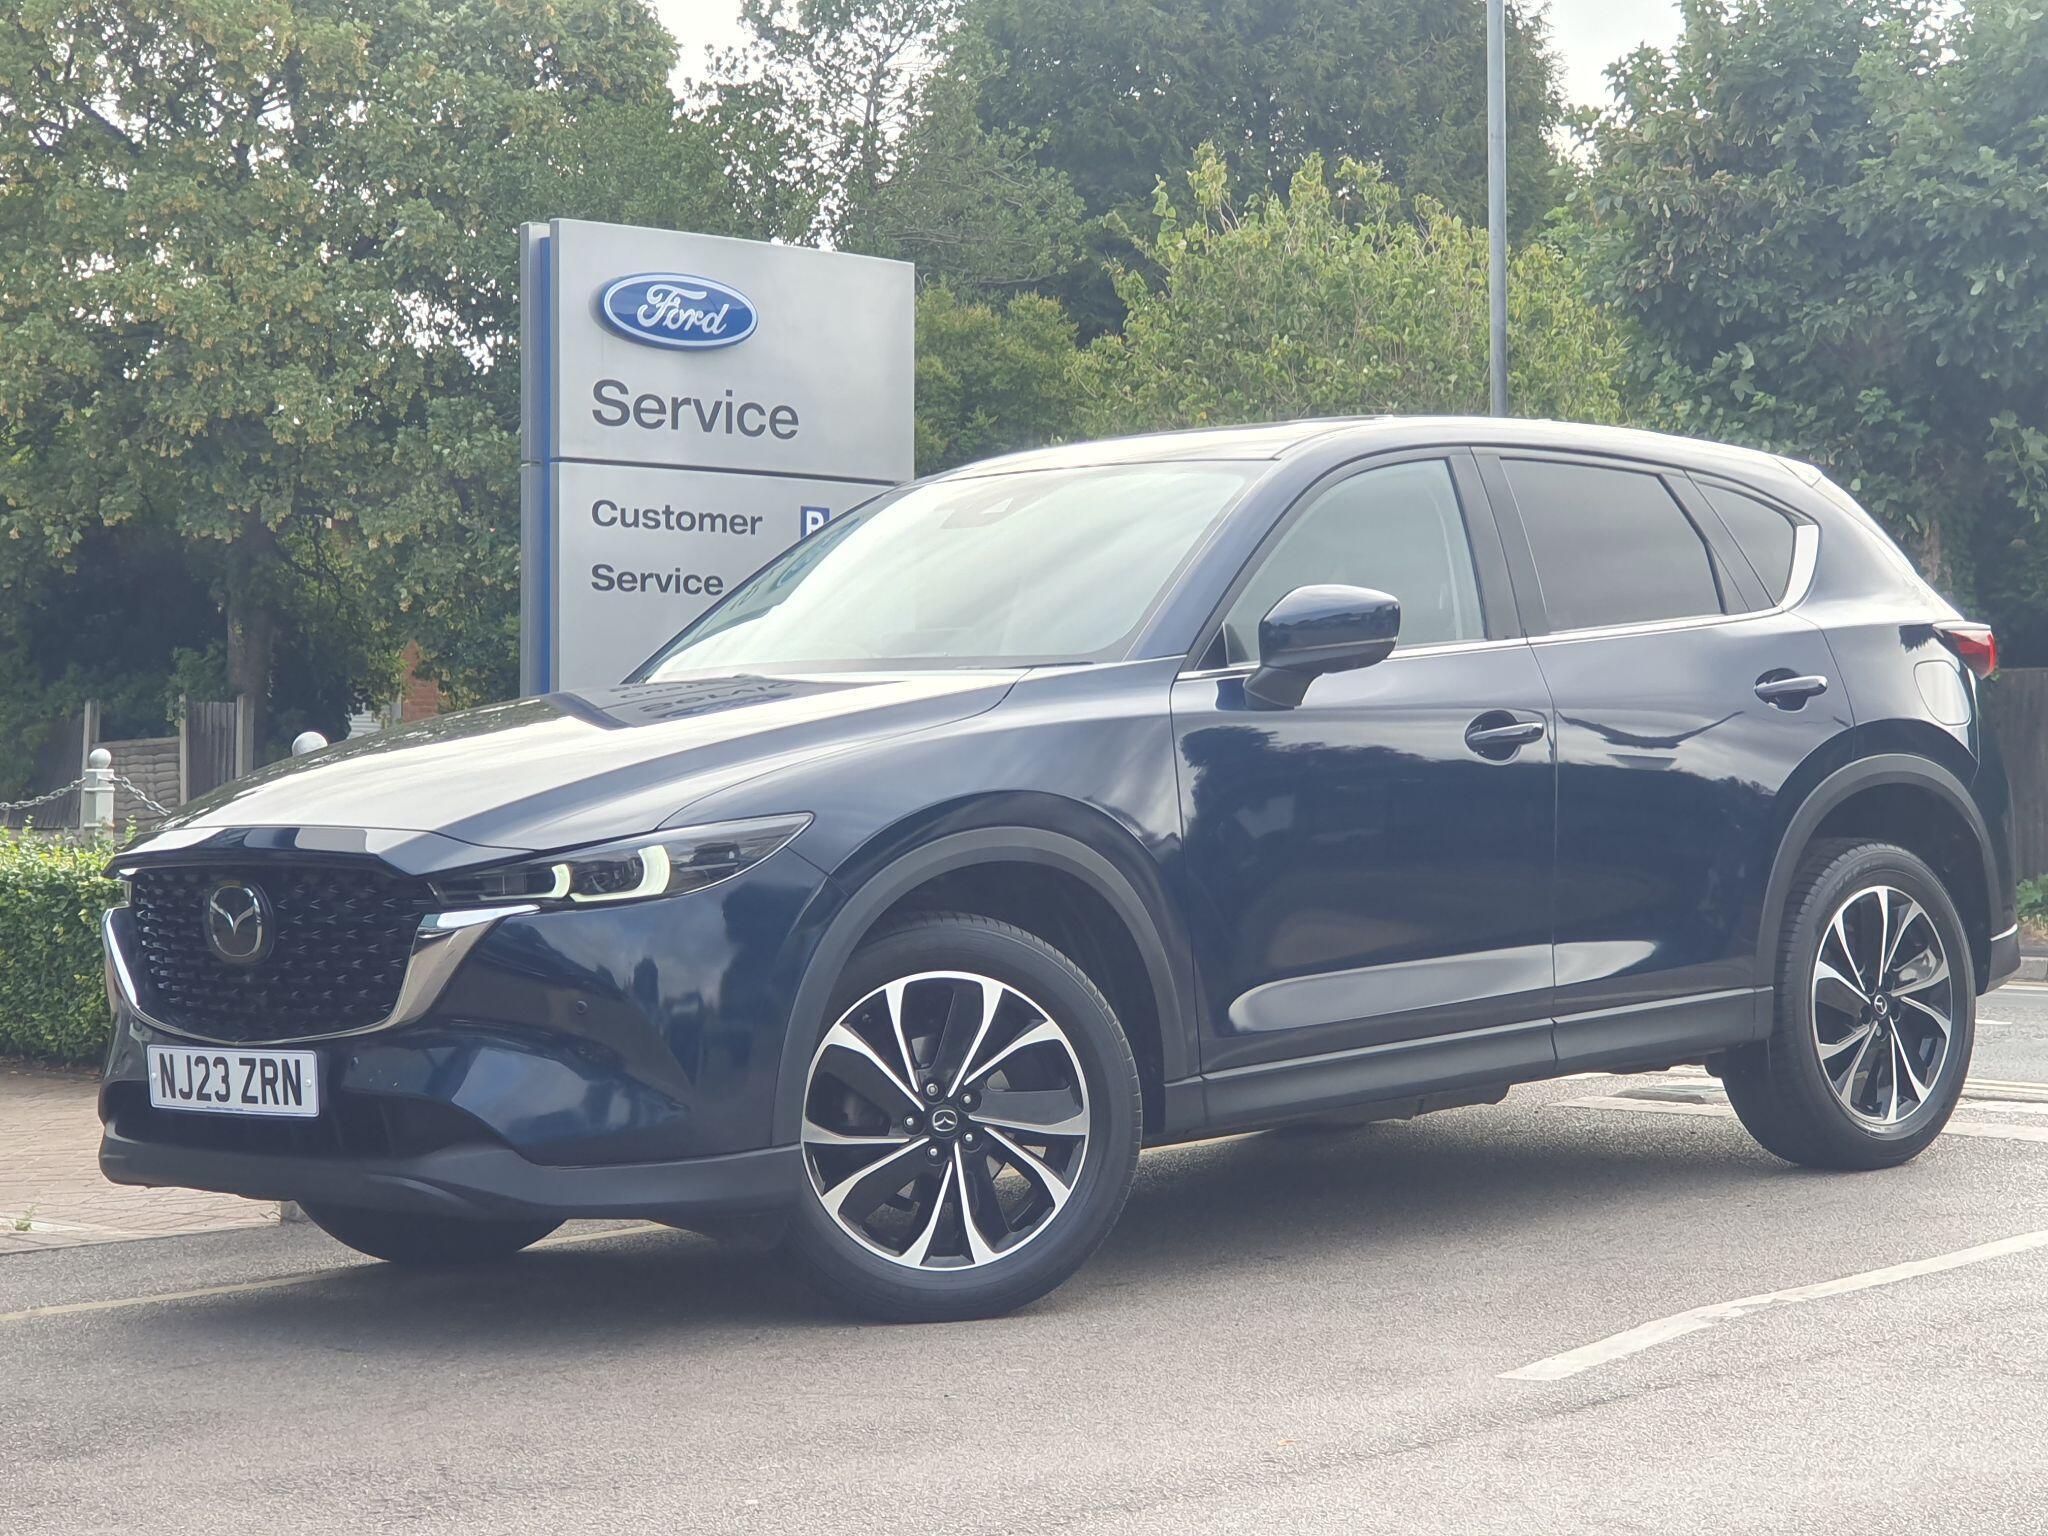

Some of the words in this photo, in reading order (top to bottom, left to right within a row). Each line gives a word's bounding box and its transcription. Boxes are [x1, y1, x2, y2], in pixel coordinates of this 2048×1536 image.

[636, 283, 730, 335] Ford
[592, 378, 799, 440] Service
[591, 499, 763, 535] Customer
[591, 563, 724, 596] Service
[158, 1052, 231, 1103] NJ23
[238, 1057, 303, 1106] ZRN
